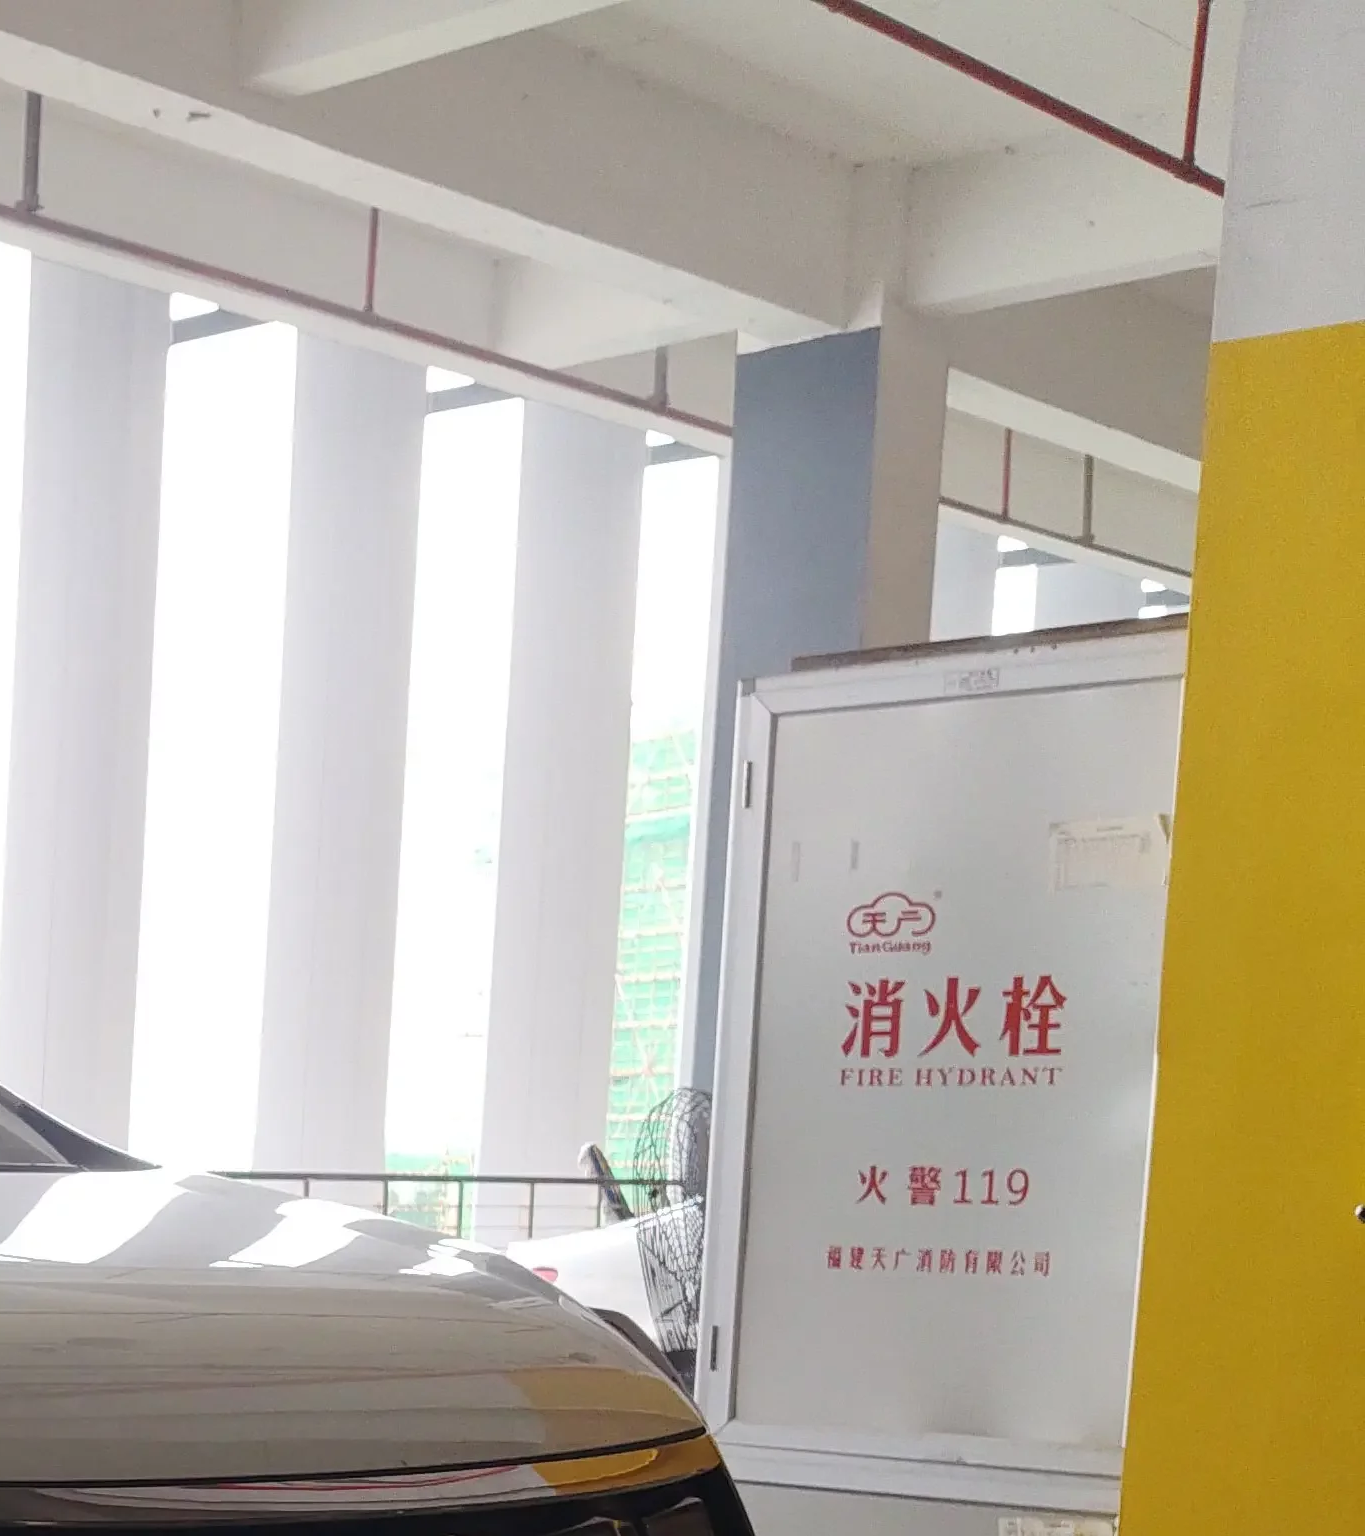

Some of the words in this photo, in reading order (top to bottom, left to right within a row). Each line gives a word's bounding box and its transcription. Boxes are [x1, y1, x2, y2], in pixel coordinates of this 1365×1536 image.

[840, 974, 1068, 1059] 消火栓
[839, 1067, 904, 1088] FIRE
[914, 1066, 1064, 1088] HYDRANT
[826, 1244, 1051, 1278] 福建天广消防有限公司
